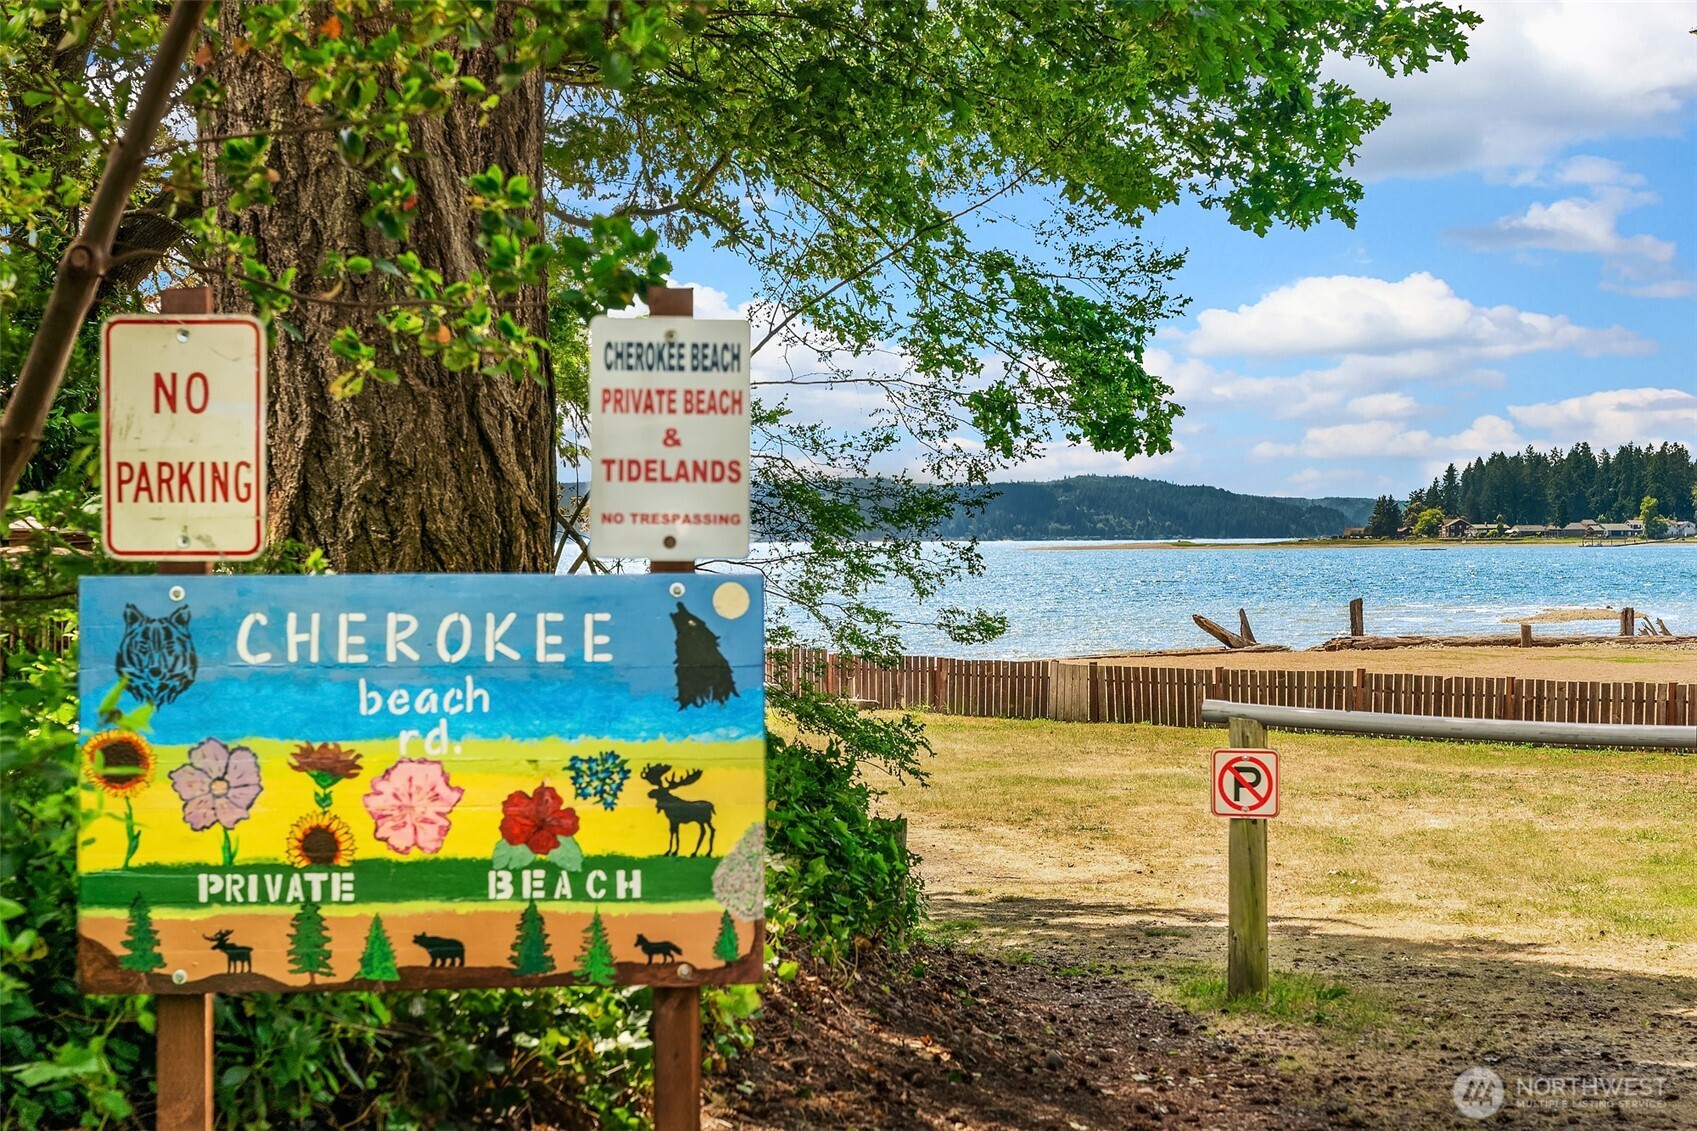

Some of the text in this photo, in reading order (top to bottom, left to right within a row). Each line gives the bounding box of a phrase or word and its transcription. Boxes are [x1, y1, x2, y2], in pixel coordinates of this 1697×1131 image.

[604, 342, 742, 373] CHEROKEE BEACH
[154, 372, 210, 414] NO
[601, 388, 743, 415] PRIVATE BEACH
[662, 428, 682, 448] &
[116, 461, 252, 503] PARKING
[601, 459, 742, 484] TIDELANDS
[601, 513, 742, 526] NO TRESPASSING
[236, 611, 613, 664] CHEROKEE
[358, 675, 490, 716] beach
[399, 717, 463, 756] rd.
[1233, 766, 1262, 802] P
[198, 869, 642, 903] PRIVATE BEACH
